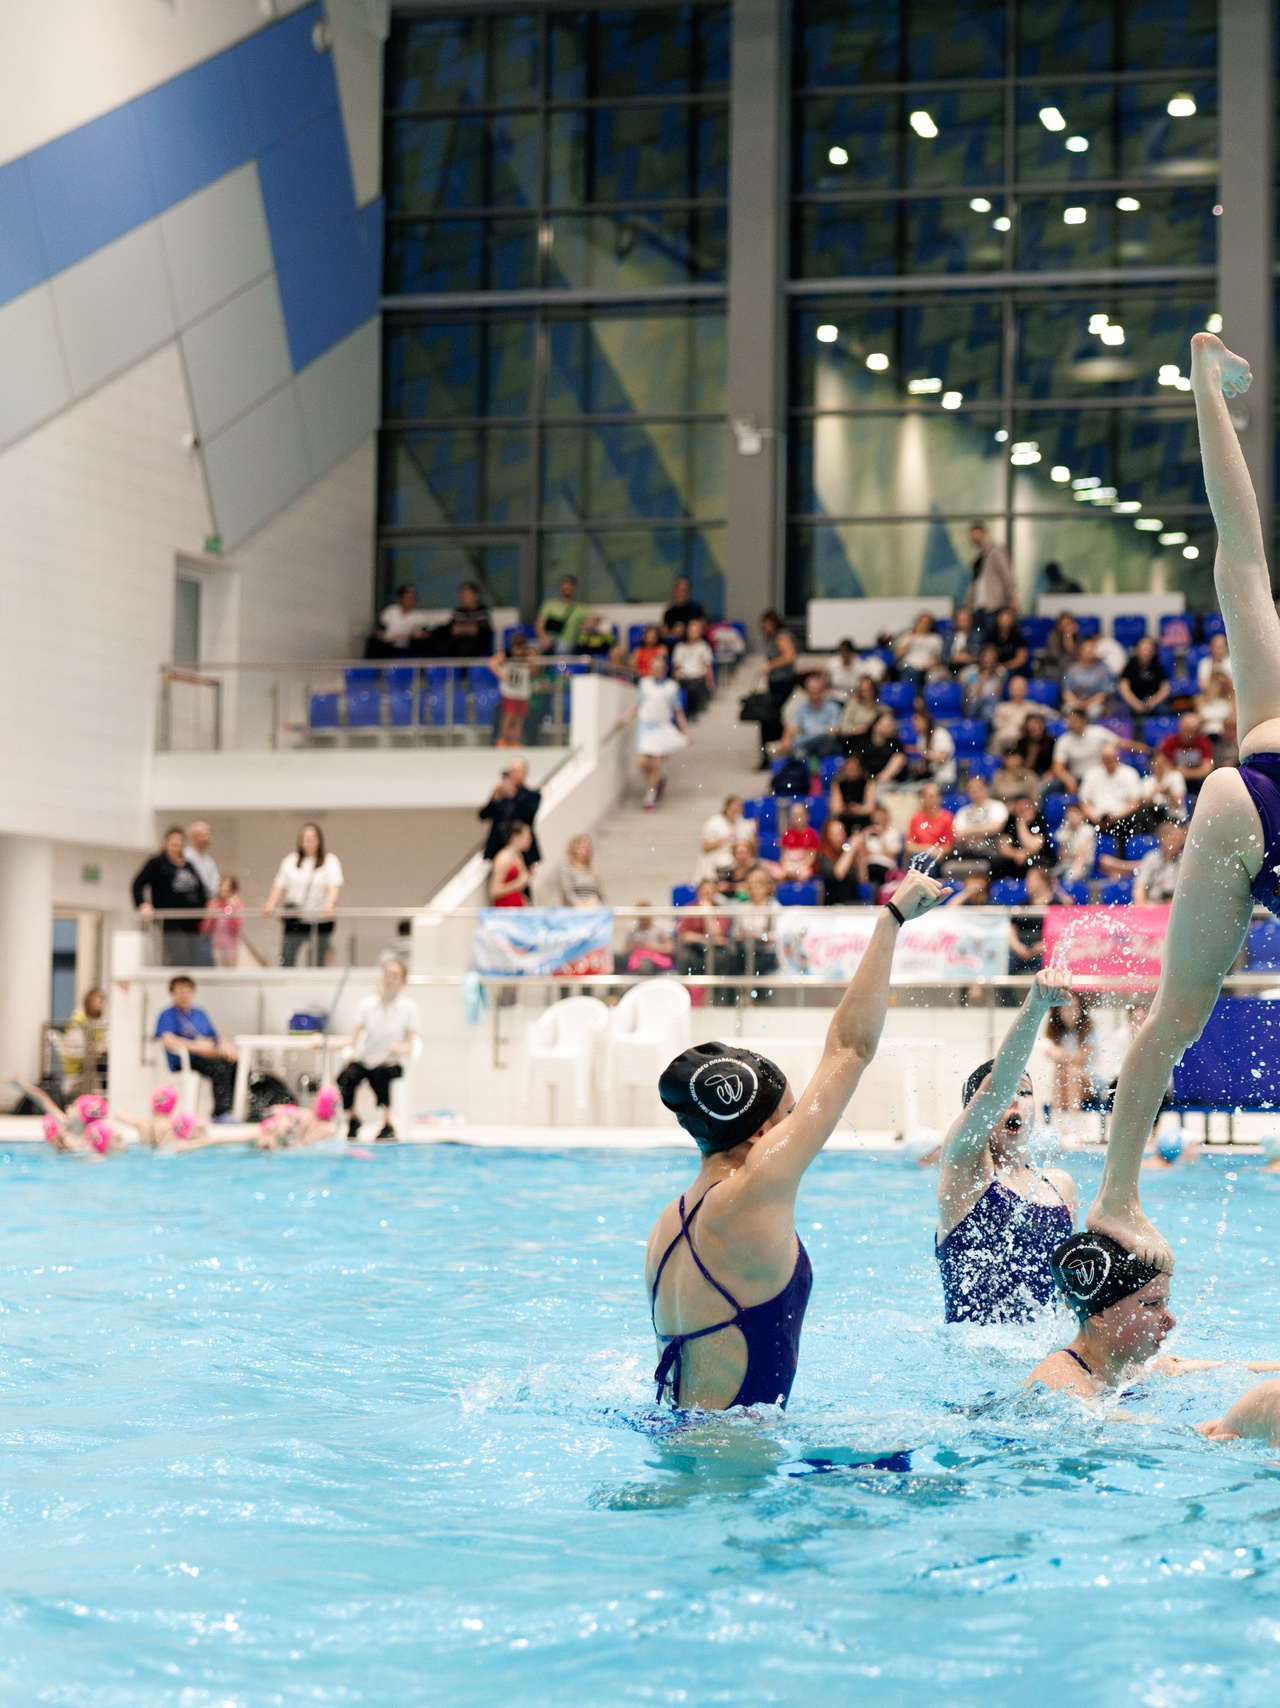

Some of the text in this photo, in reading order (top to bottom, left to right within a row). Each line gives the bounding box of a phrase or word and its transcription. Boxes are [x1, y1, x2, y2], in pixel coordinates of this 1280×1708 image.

[697, 1101, 710, 1113] ЛИГА
[709, 1057, 742, 1066] ПЛАВАНИЯ
[739, 1090, 758, 1115] МОСКВА
[1089, 1277, 1106, 1299] МОСКВА
